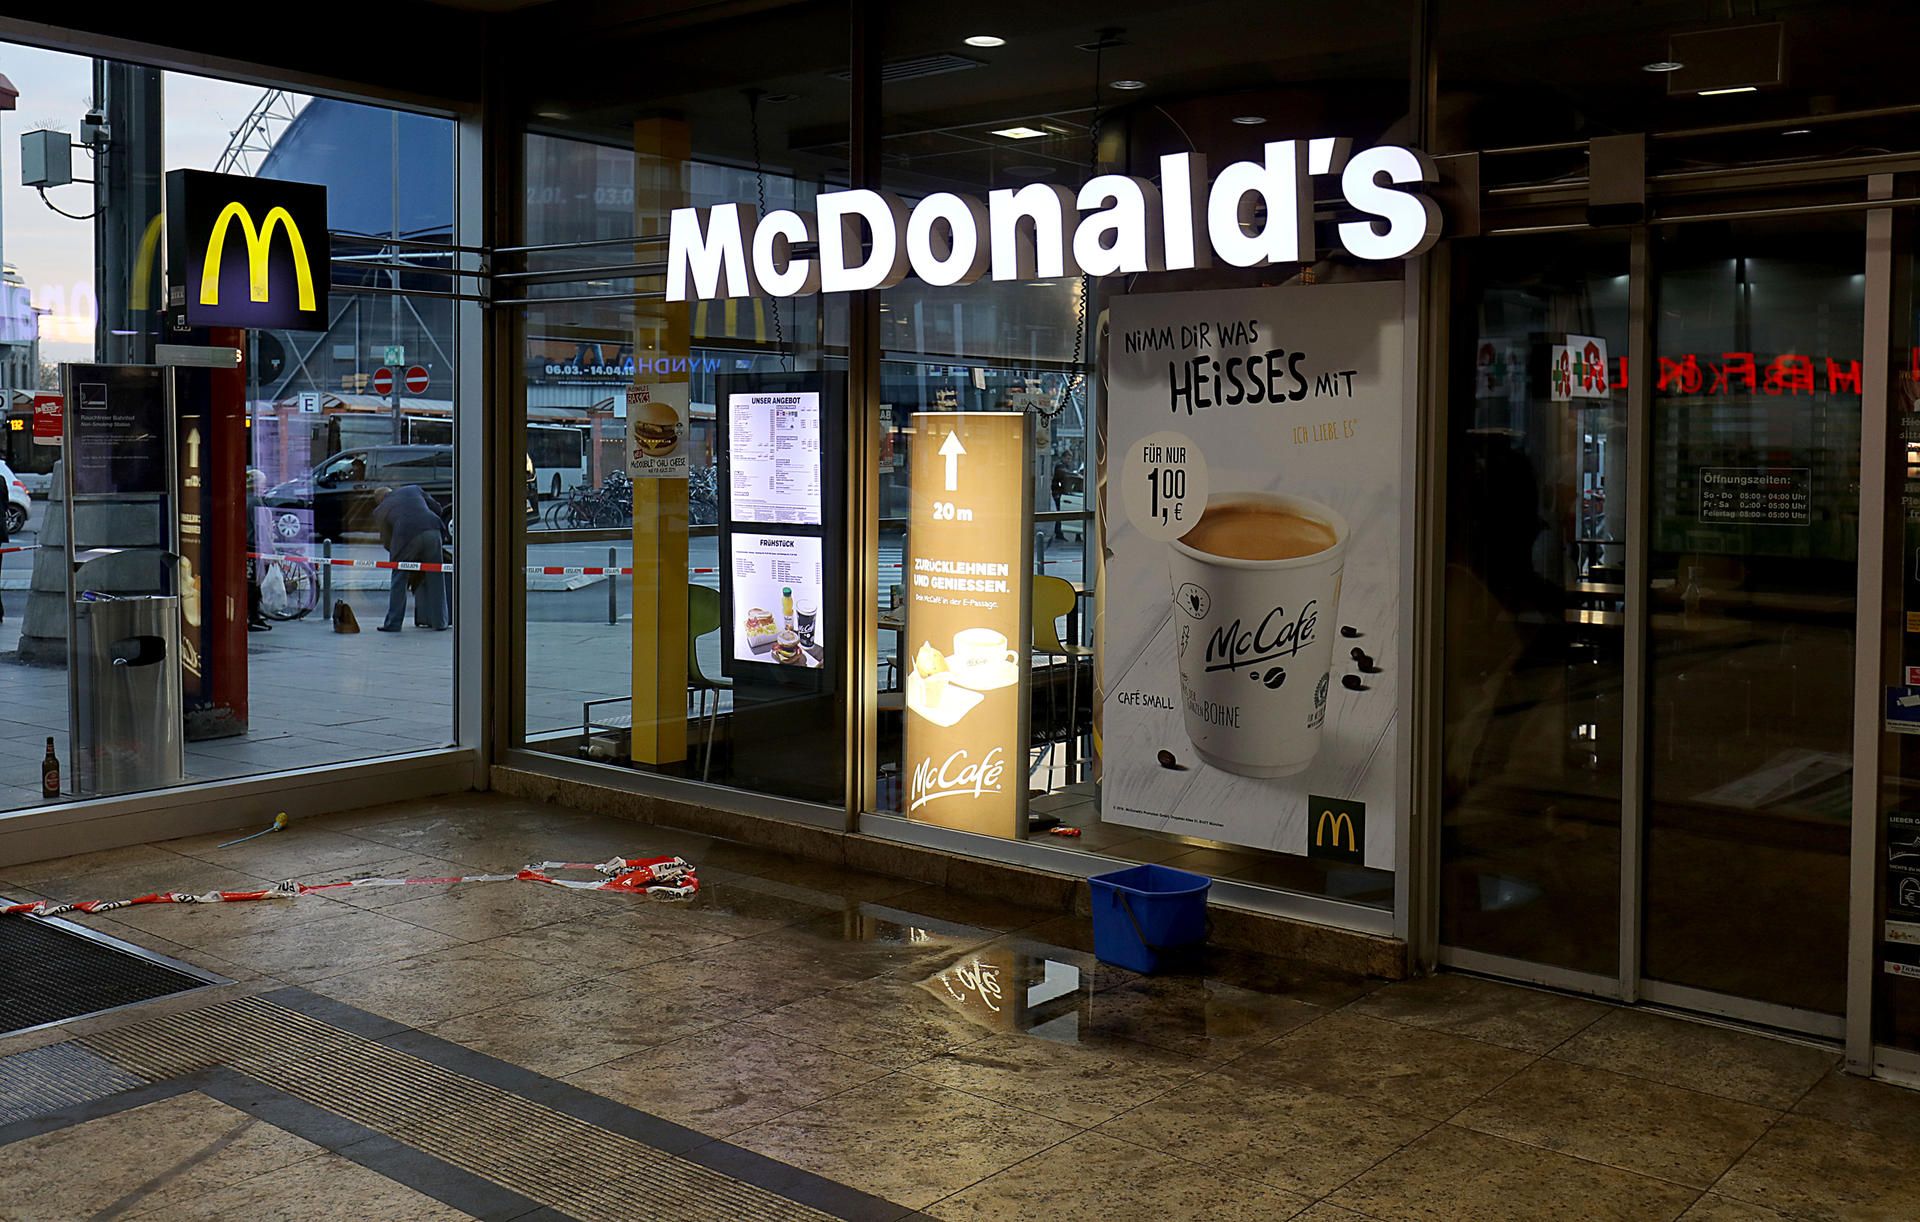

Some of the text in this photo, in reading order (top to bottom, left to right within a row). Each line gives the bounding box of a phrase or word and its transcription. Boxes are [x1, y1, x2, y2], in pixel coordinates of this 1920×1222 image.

[665, 138, 1428, 302] McDonald's
[1217, 320, 1258, 349] WAS
[305, 398, 314, 412] E
[751, 397, 772, 405] UNSER
[1293, 426, 1309, 445] ICH
[1313, 422, 1339, 442] LIEBE
[1144, 443, 1186, 464] FÜR NUR
[1704, 472, 1791, 486] Öffnungszeiten:
[1703, 492, 1714, 500] So
[1722, 492, 1733, 500] Do
[1792, 493, 1807, 501] Uhr
[1703, 500, 1712, 508] Fr
[1792, 502, 1807, 510] Uhr
[932, 502, 973, 521] 20 m
[1792, 511, 1807, 519] Uhr
[760, 539, 795, 548] FRÜHSTÜCK
[914, 557, 1009, 577] ZURÜCKLEHNEN
[913, 574, 1011, 594] UND GENIESSEN.
[1205, 600, 1318, 671] McCafé
[1118, 689, 1174, 710] CAFÉ SMALL
[1203, 701, 1241, 729] BOHNE
[911, 747, 1004, 811] McCafé
